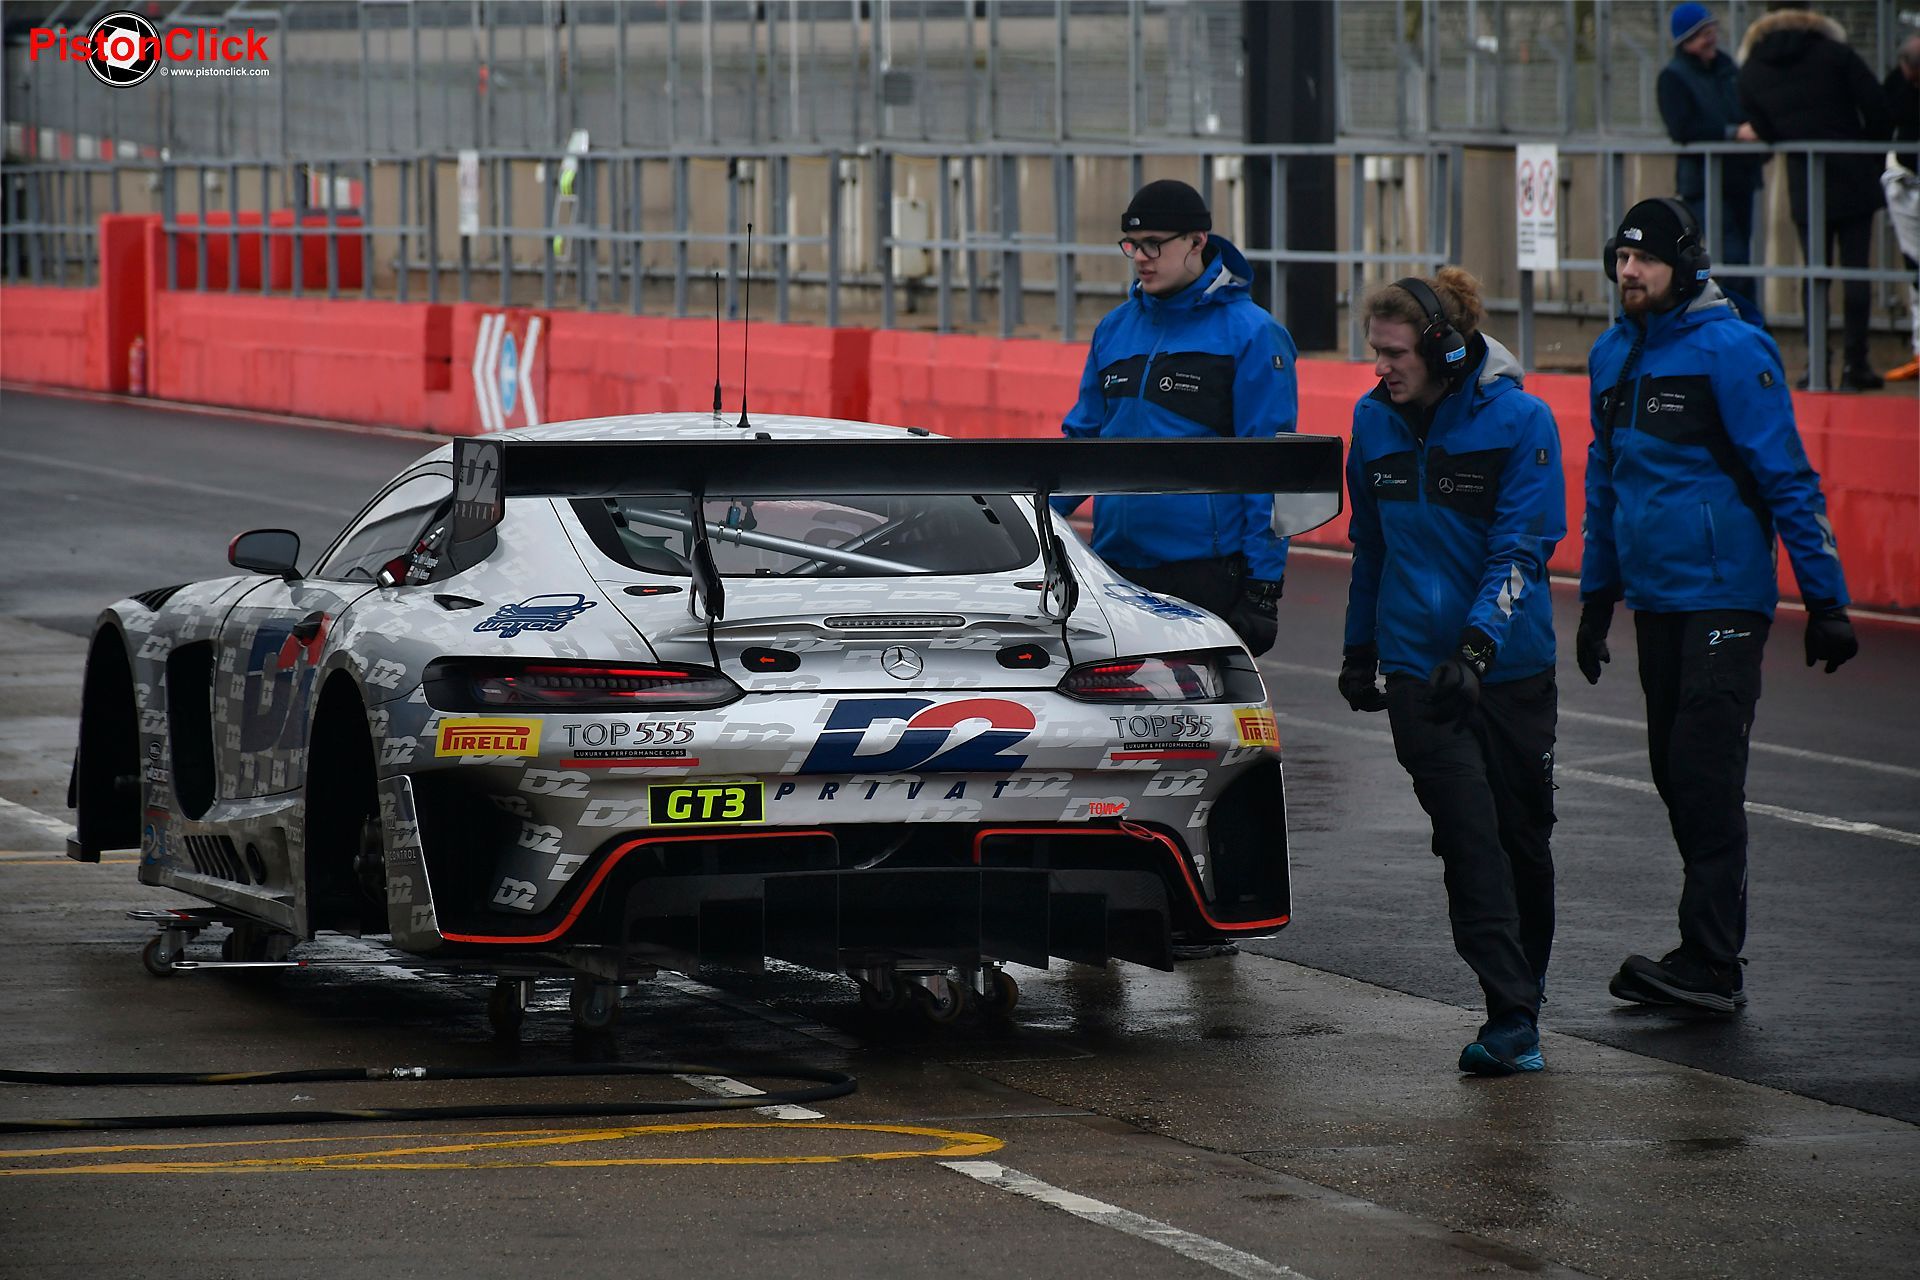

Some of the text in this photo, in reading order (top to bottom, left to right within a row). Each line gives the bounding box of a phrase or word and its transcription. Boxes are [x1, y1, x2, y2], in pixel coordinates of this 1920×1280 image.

[457, 443, 498, 504] D2
[454, 503, 495, 520] PRIVAT
[478, 620, 563, 630] WATCH
[136, 635, 173, 662] D2
[365, 658, 407, 690] D2
[442, 726, 530, 751] PIRELLI
[563, 721, 697, 747] TOP 555
[798, 698, 1037, 774] D2
[1110, 714, 1214, 738] TOP 555
[380, 735, 417, 766] D2
[518, 768, 591, 798] D2
[1000, 772, 1074, 798] D2
[1142, 768, 1209, 797] D2
[667, 787, 746, 820] GT3
[1090, 802, 1115, 815] TOW
[518, 821, 563, 854] D2
[493, 876, 538, 911] D2
